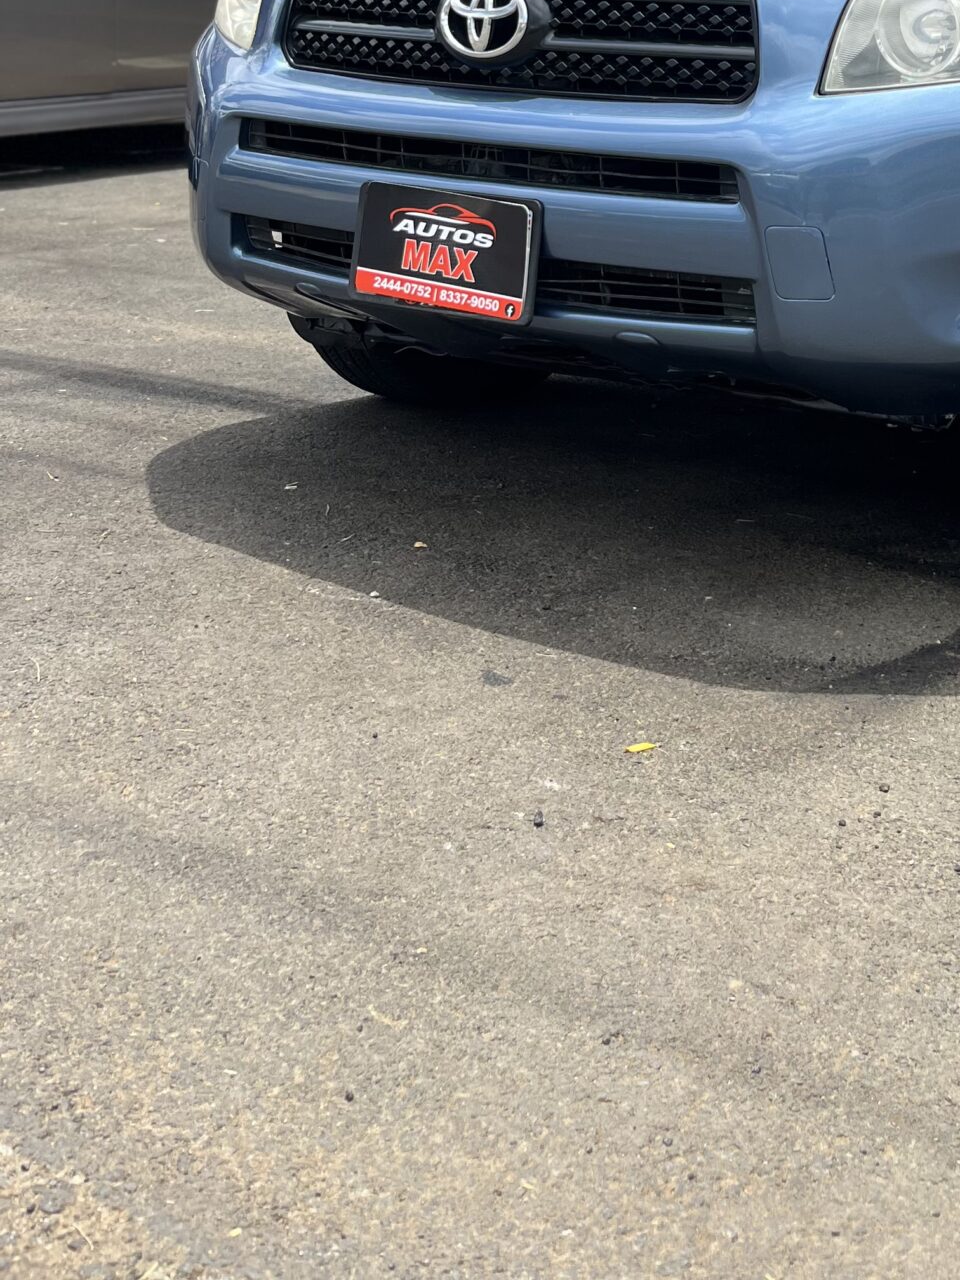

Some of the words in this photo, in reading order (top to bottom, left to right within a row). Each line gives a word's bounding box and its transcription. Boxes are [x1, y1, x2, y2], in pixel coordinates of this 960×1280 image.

[393, 219, 495, 248] AUTOS
[401, 238, 478, 283] MAX
[373, 276, 431, 298] 2444-0752
[439, 289, 500, 312] 8337-9050
